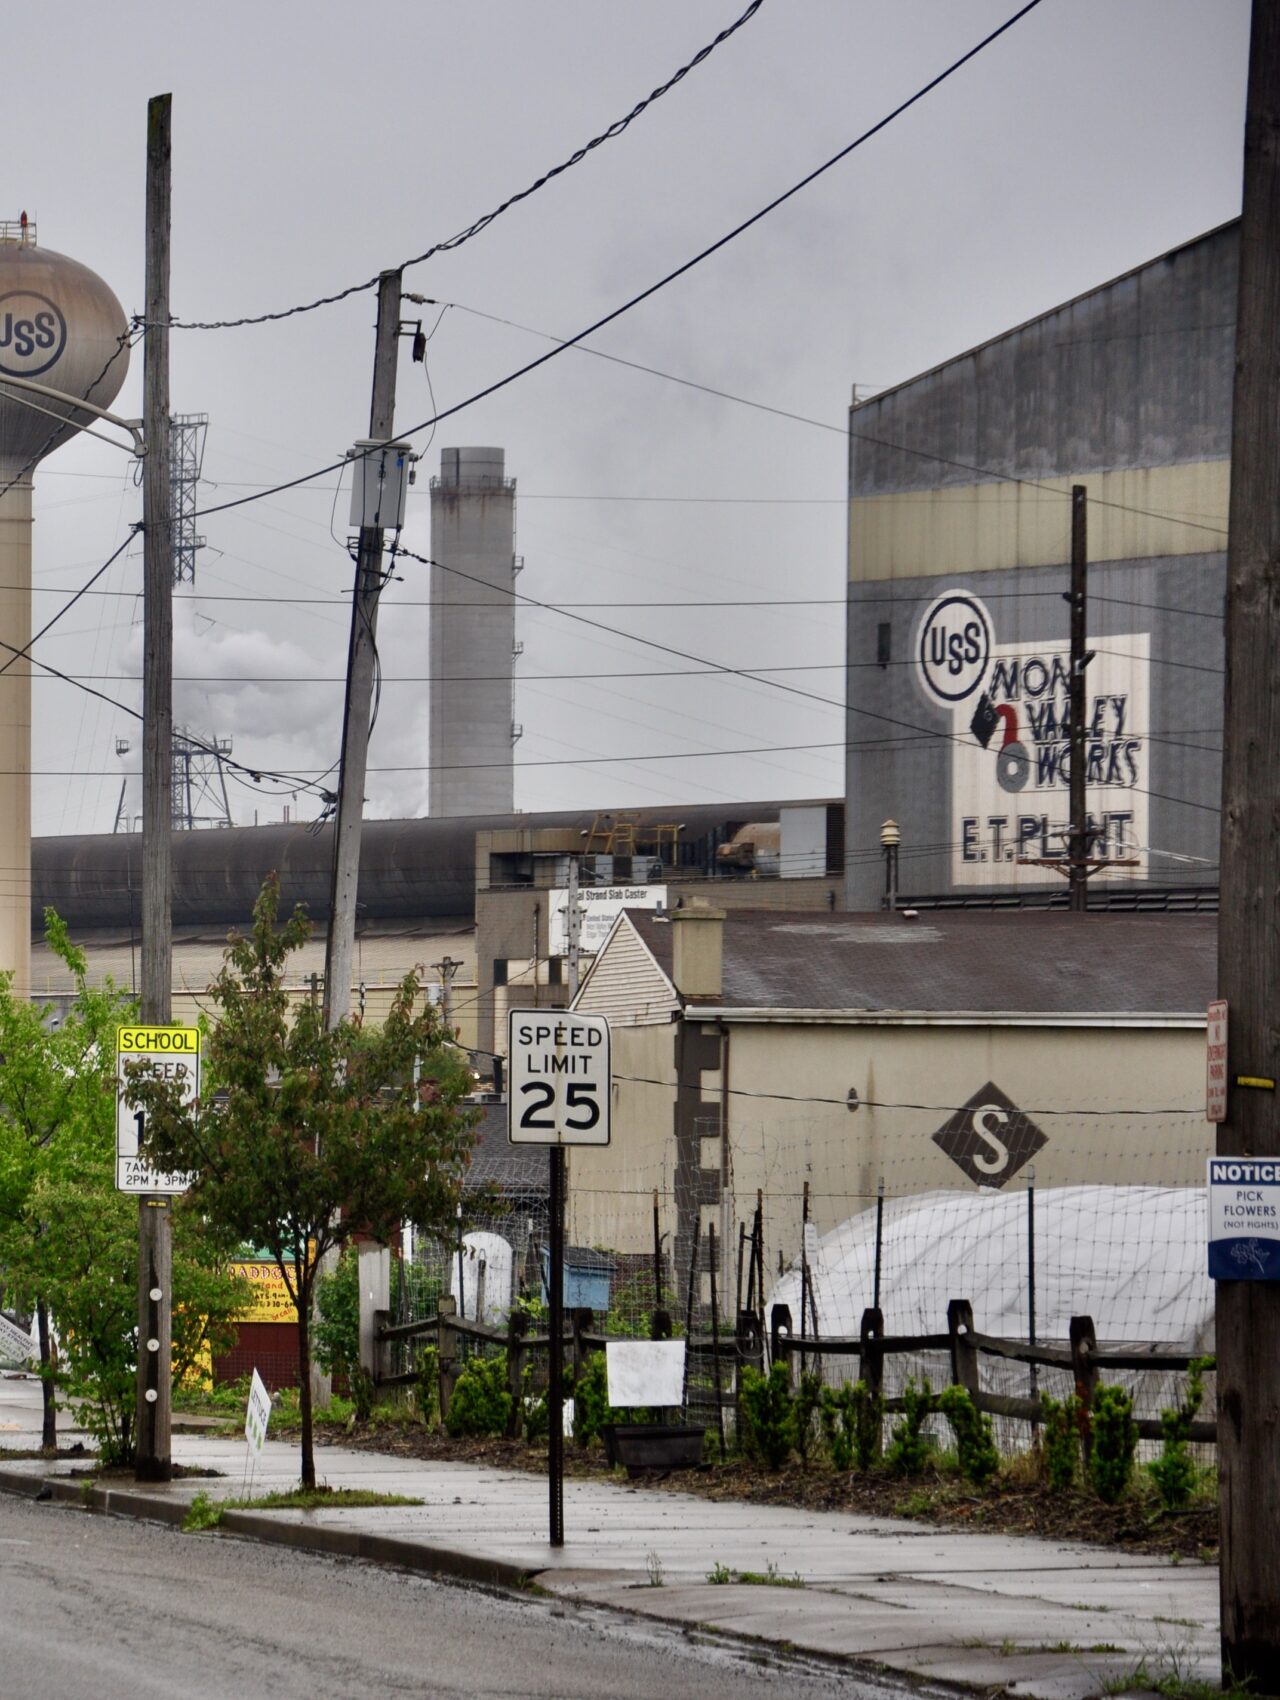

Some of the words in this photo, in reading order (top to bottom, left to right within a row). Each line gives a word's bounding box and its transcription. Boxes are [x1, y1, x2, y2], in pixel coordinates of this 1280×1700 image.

[931, 622, 981, 675] USS
[989, 655, 1071, 700] MON
[1024, 694, 1128, 744] VALEY
[1017, 810, 1133, 861] PLNT
[586, 890, 607, 900] Strand
[609, 889, 623, 900] Slab
[625, 888, 647, 899] Caster
[123, 1032, 194, 1050] SCHOOL
[519, 1026, 602, 1046] SPEED
[528, 1054, 592, 1074] LIMIT
[520, 1081, 600, 1130] 25
[972, 1104, 1009, 1174] S
[126, 1175, 148, 1185] 2PM
[164, 1176, 187, 1186] 3PM
[1213, 1164, 1280, 1181] NOTICE
[1236, 1191, 1264, 1201] PICK
[1224, 1205, 1277, 1216] FLOWERS
[1223, 1221, 1245, 1230] (NOT
[1247, 1221, 1279, 1230] FIGHTS)
[226, 1265, 298, 1280] RADDOC
